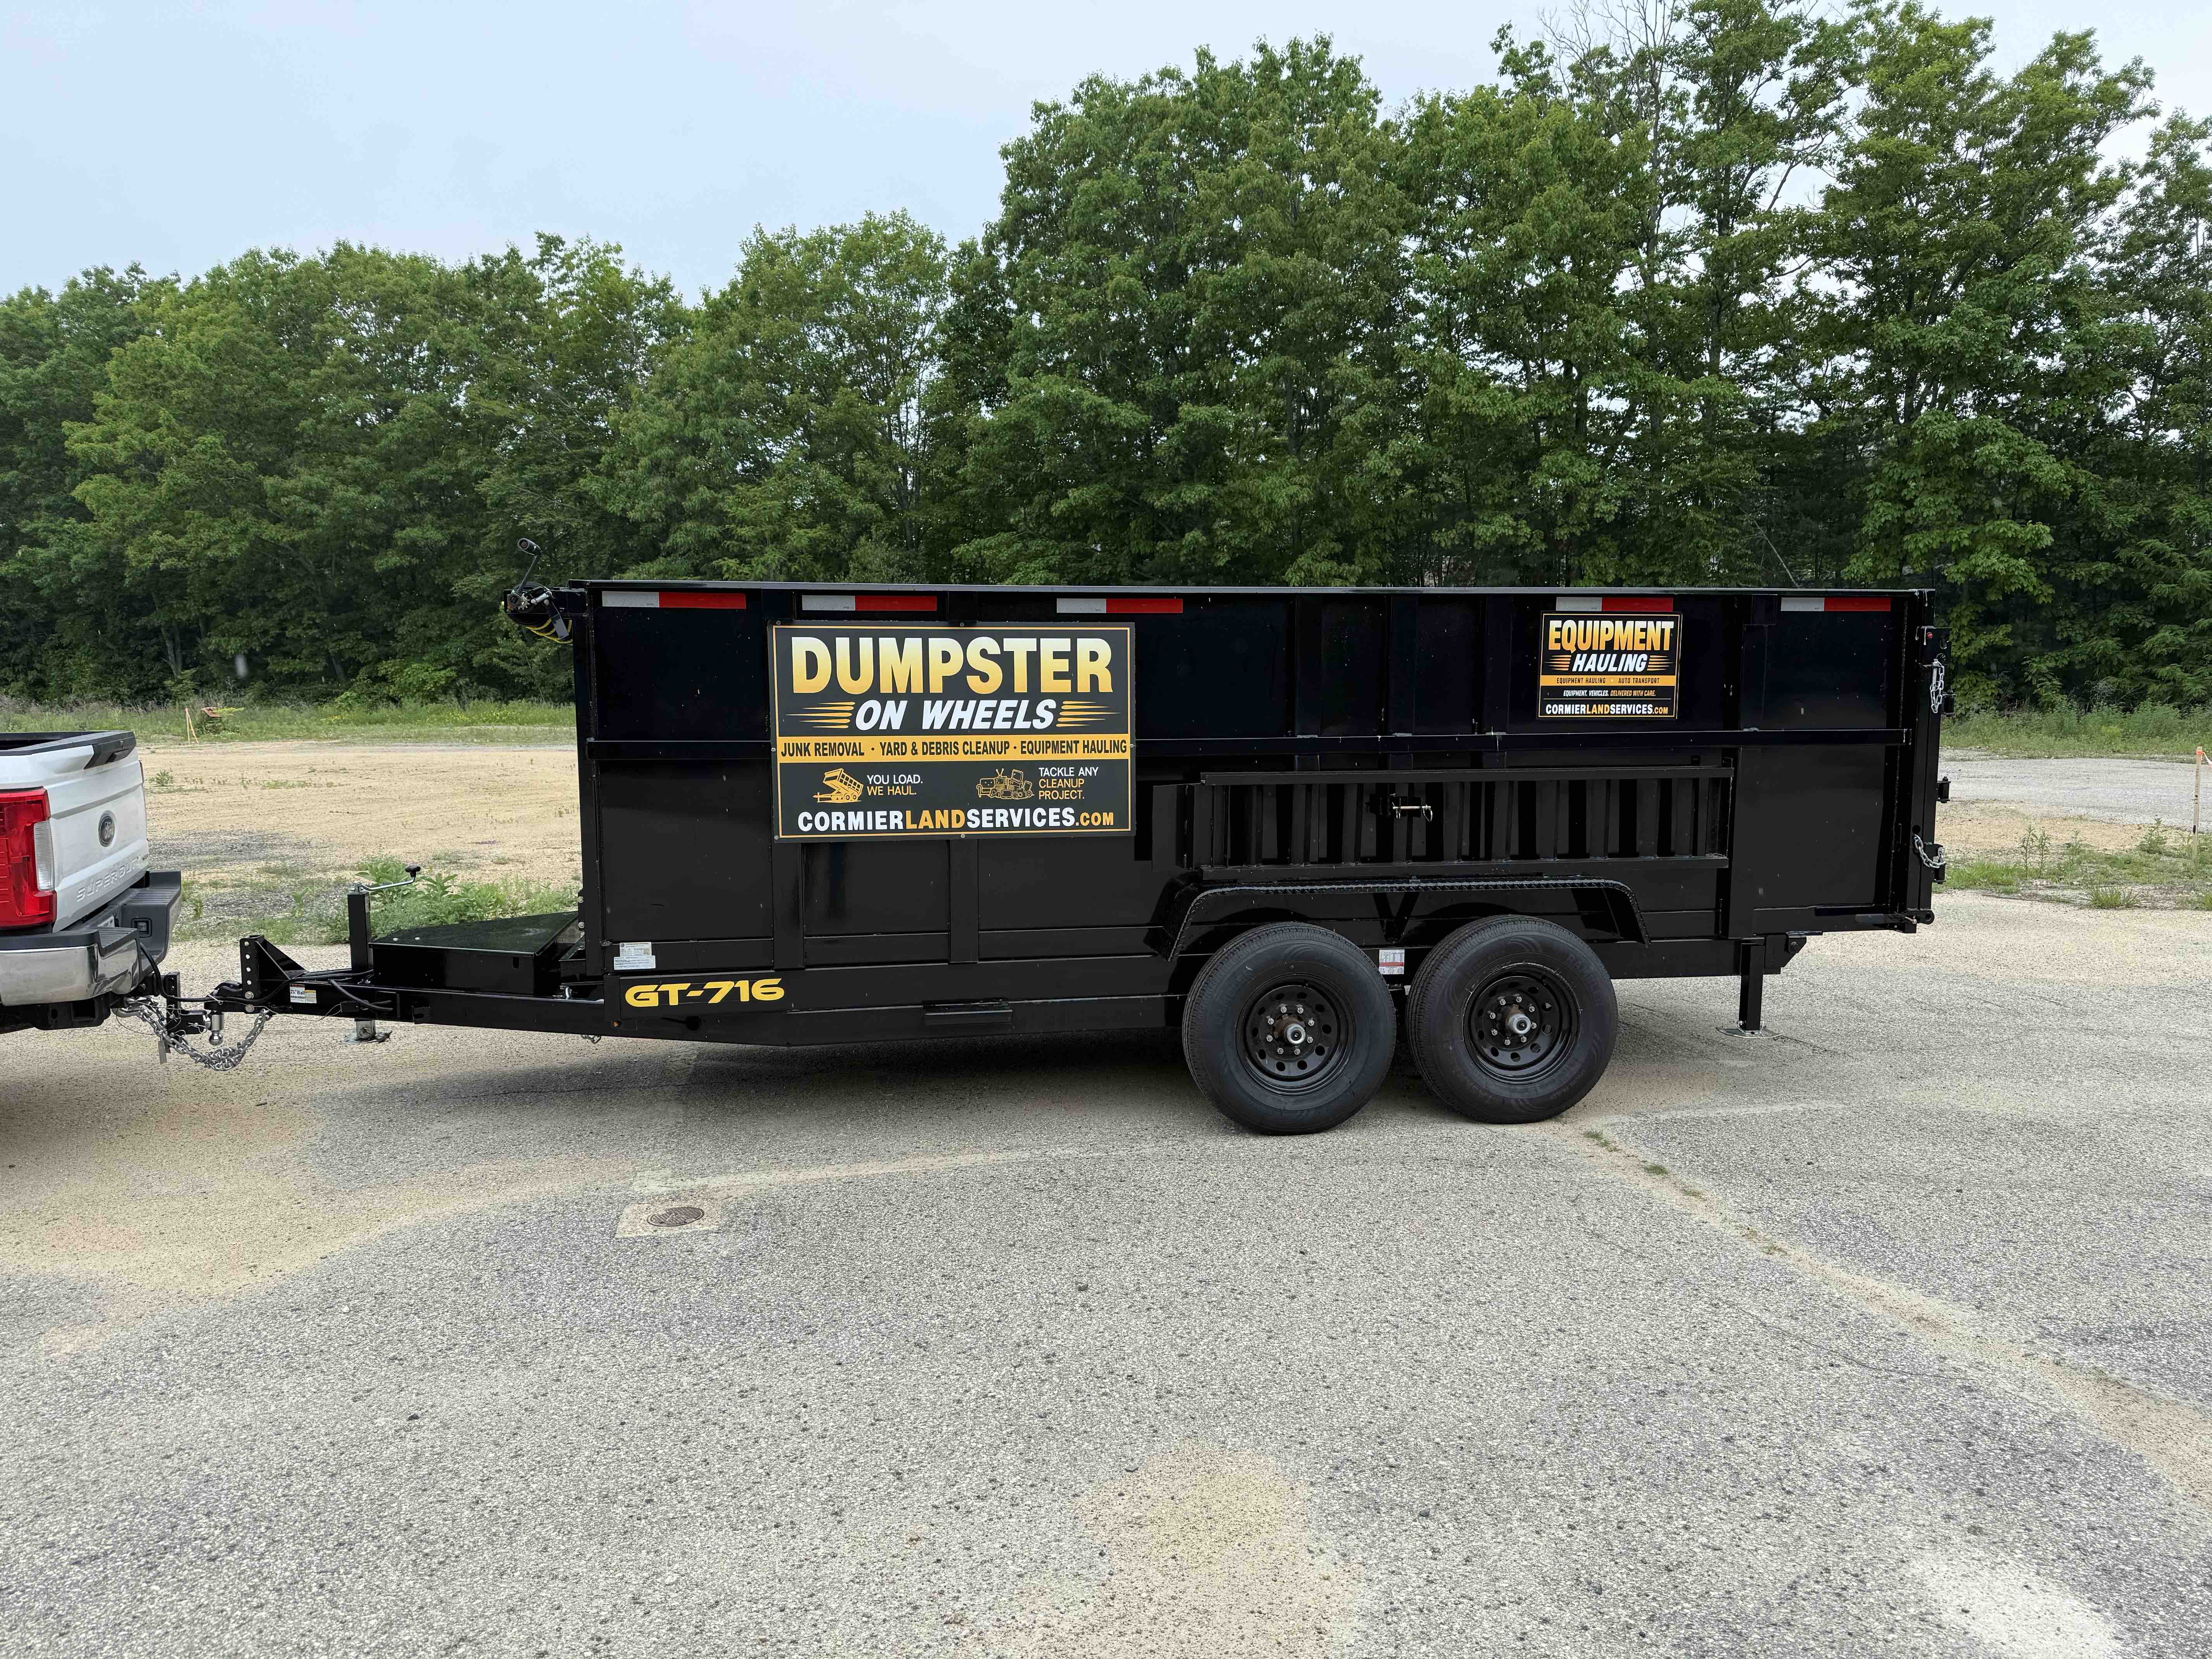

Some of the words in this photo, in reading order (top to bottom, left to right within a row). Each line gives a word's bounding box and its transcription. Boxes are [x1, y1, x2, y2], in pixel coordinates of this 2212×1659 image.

[1549, 620, 1674, 653] EQUIPMENT
[792, 636, 1113, 694] DUMPSTER
[1572, 654, 1647, 672] HAULING
[855, 700, 907, 730] ON
[922, 699, 1056, 730] WHEELS
[1546, 704, 1668, 714] CORMIERLANDSERVICES.COM
[781, 742, 811, 757] JUNK
[814, 742, 864, 756] REMOVAL
[880, 741, 908, 755] YARD
[911, 741, 919, 754] &
[922, 741, 959, 754] DEBRIS
[962, 741, 1010, 754] CLEANUP
[1020, 740, 1079, 754] EQUIPMENT
[1082, 740, 1127, 753] HAULING
[867, 775, 890, 785] YOU
[893, 774, 923, 784] LOAD.
[1038, 767, 1074, 776] TACKLE
[1078, 767, 1099, 776] ANY
[867, 786, 884, 795] WE
[888, 786, 917, 795] HAUL.
[1038, 779, 1084, 788] CLEANUP
[1038, 790, 1084, 800] PROJECT.
[798, 807, 1114, 831] CORMIERLANDSERVICES.COM
[77, 871, 118, 902] SUPER
[625, 978, 785, 1007] GT-716
